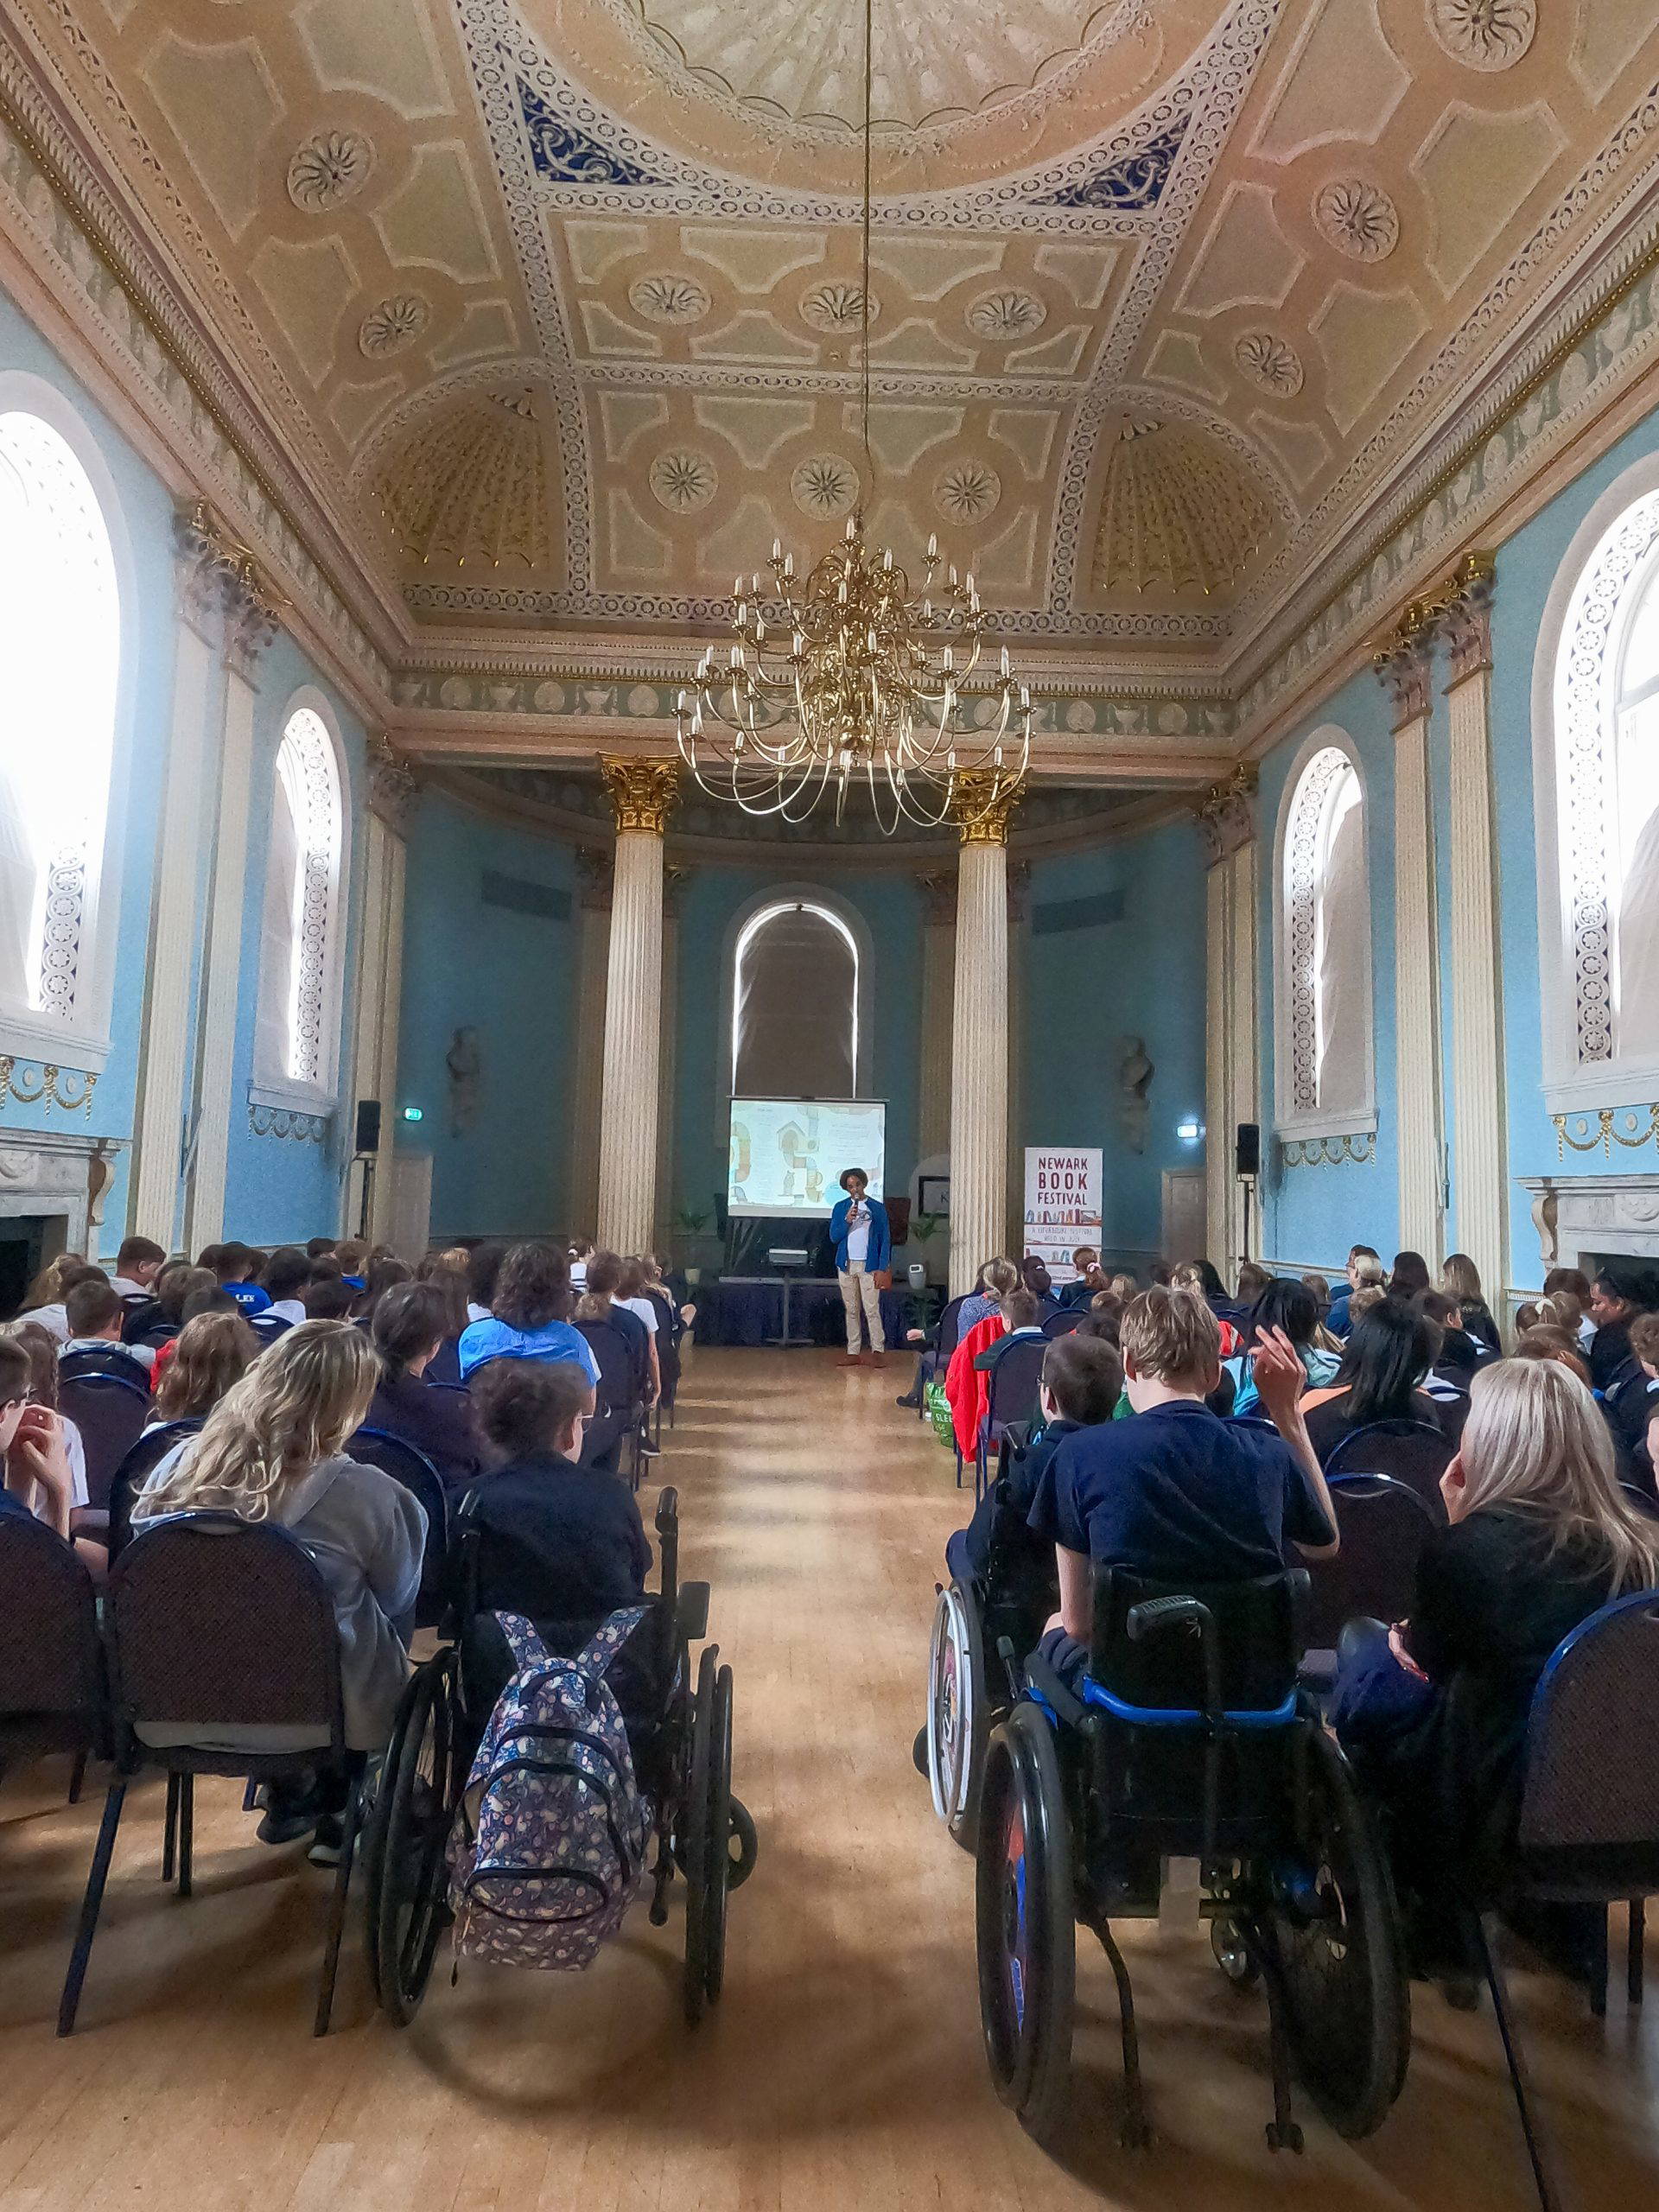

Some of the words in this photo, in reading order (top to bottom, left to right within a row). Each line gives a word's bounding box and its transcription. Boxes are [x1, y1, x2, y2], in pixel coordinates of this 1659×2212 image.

[1038, 1157, 1088, 1170] NEWARK
[1039, 1172, 1088, 1190] BOOK
[1038, 1192, 1088, 1205] FESTIVAL
